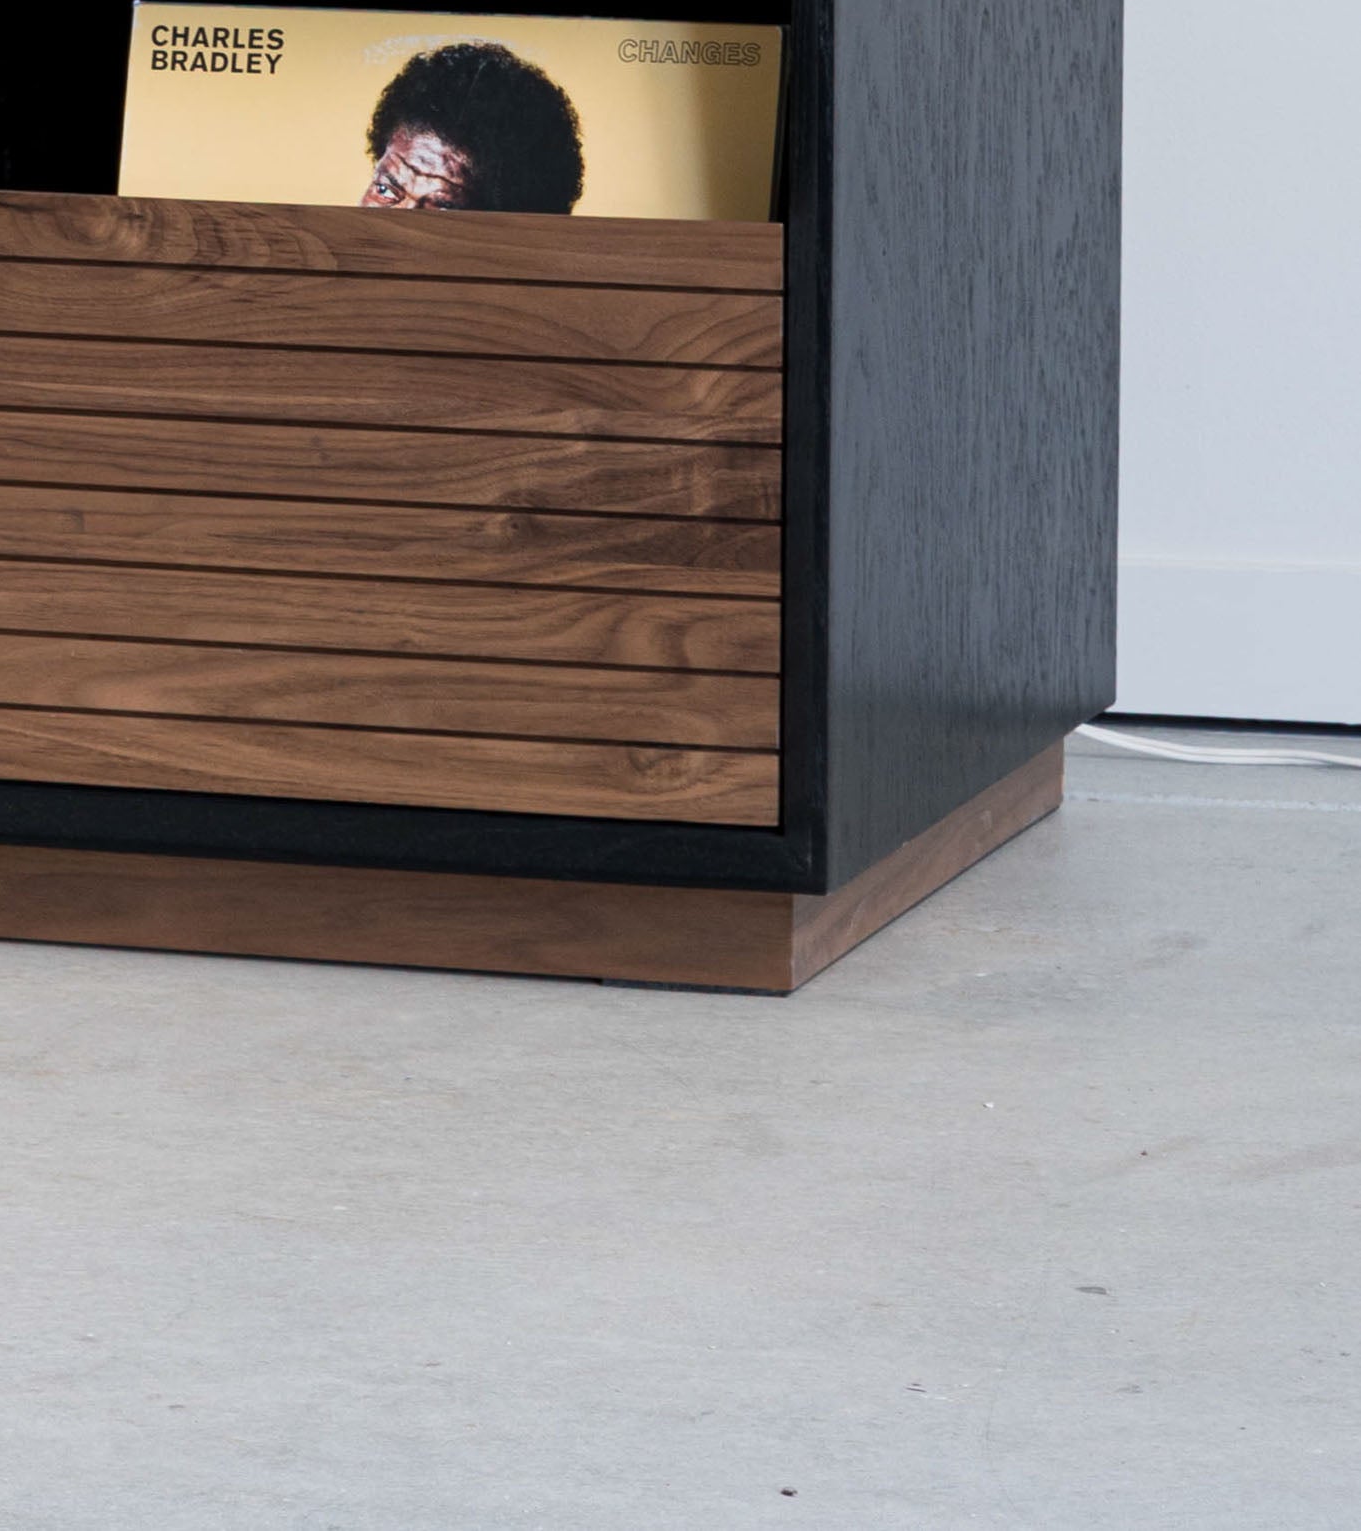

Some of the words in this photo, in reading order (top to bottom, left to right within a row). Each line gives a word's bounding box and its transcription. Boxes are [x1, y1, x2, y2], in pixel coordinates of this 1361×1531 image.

[151, 24, 285, 50] CHARLES
[151, 50, 283, 75] BRADLEY
[616, 38, 763, 68] CHANGES
